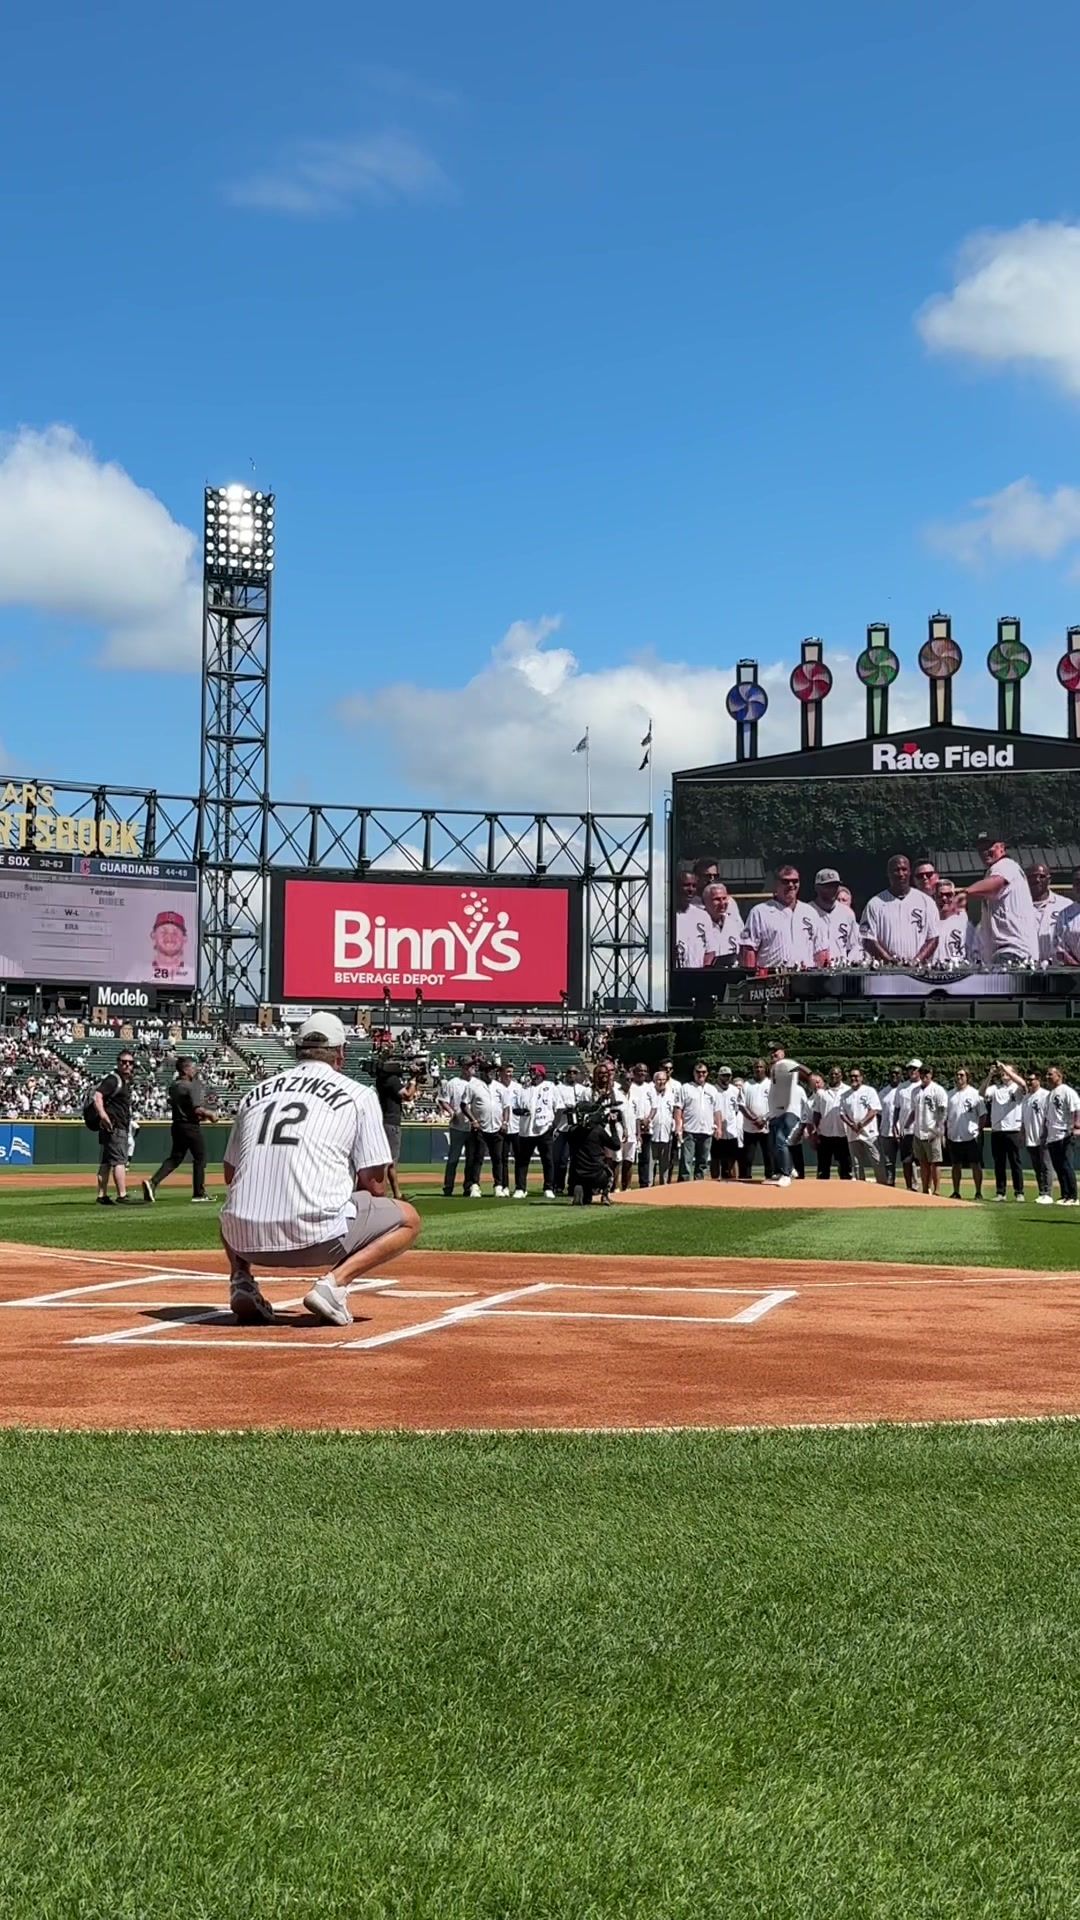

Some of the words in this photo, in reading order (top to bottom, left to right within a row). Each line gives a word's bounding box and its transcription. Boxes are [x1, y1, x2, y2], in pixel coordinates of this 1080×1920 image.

[872, 742, 940, 771] Rate
[945, 743, 1014, 769] Field
[8, 856, 30, 867] SOX
[100, 862, 160, 876] GUARDIANS
[154, 968, 169, 979] 28
[334, 972, 400, 984] BEVERAGE
[402, 973, 446, 985] DEPOT
[98, 986, 148, 1006] Modelo
[750, 988, 764, 1001] FAN
[765, 986, 785, 1000] DECK
[88, 1027, 115, 1038] Modelo
[186, 1029, 212, 1040] Modelo
[245, 1076, 353, 1111] PIERZYNSKI
[257, 1101, 309, 1146] 12
